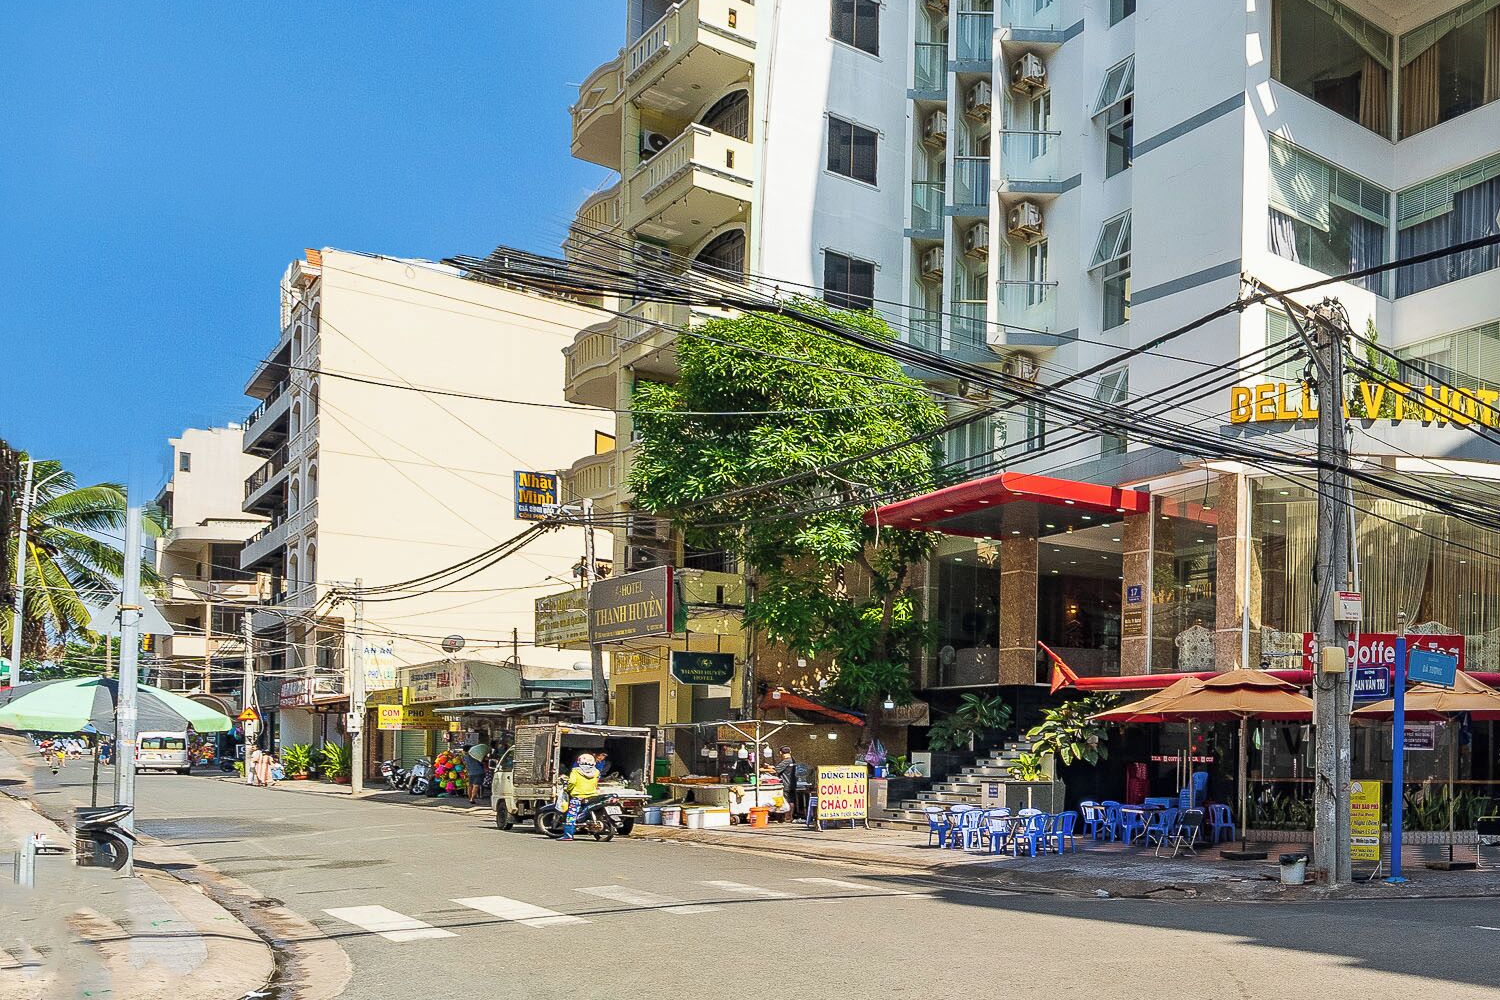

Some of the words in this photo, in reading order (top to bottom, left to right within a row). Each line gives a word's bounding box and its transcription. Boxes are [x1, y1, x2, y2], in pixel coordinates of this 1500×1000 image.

[621, 581, 643, 596] HOTEL
[1130, 588, 1138, 596] 17
[595, 605, 628, 626] THANH
[629, 591, 663, 621] HUYỀN
[821, 771, 844, 779] DŨNG
